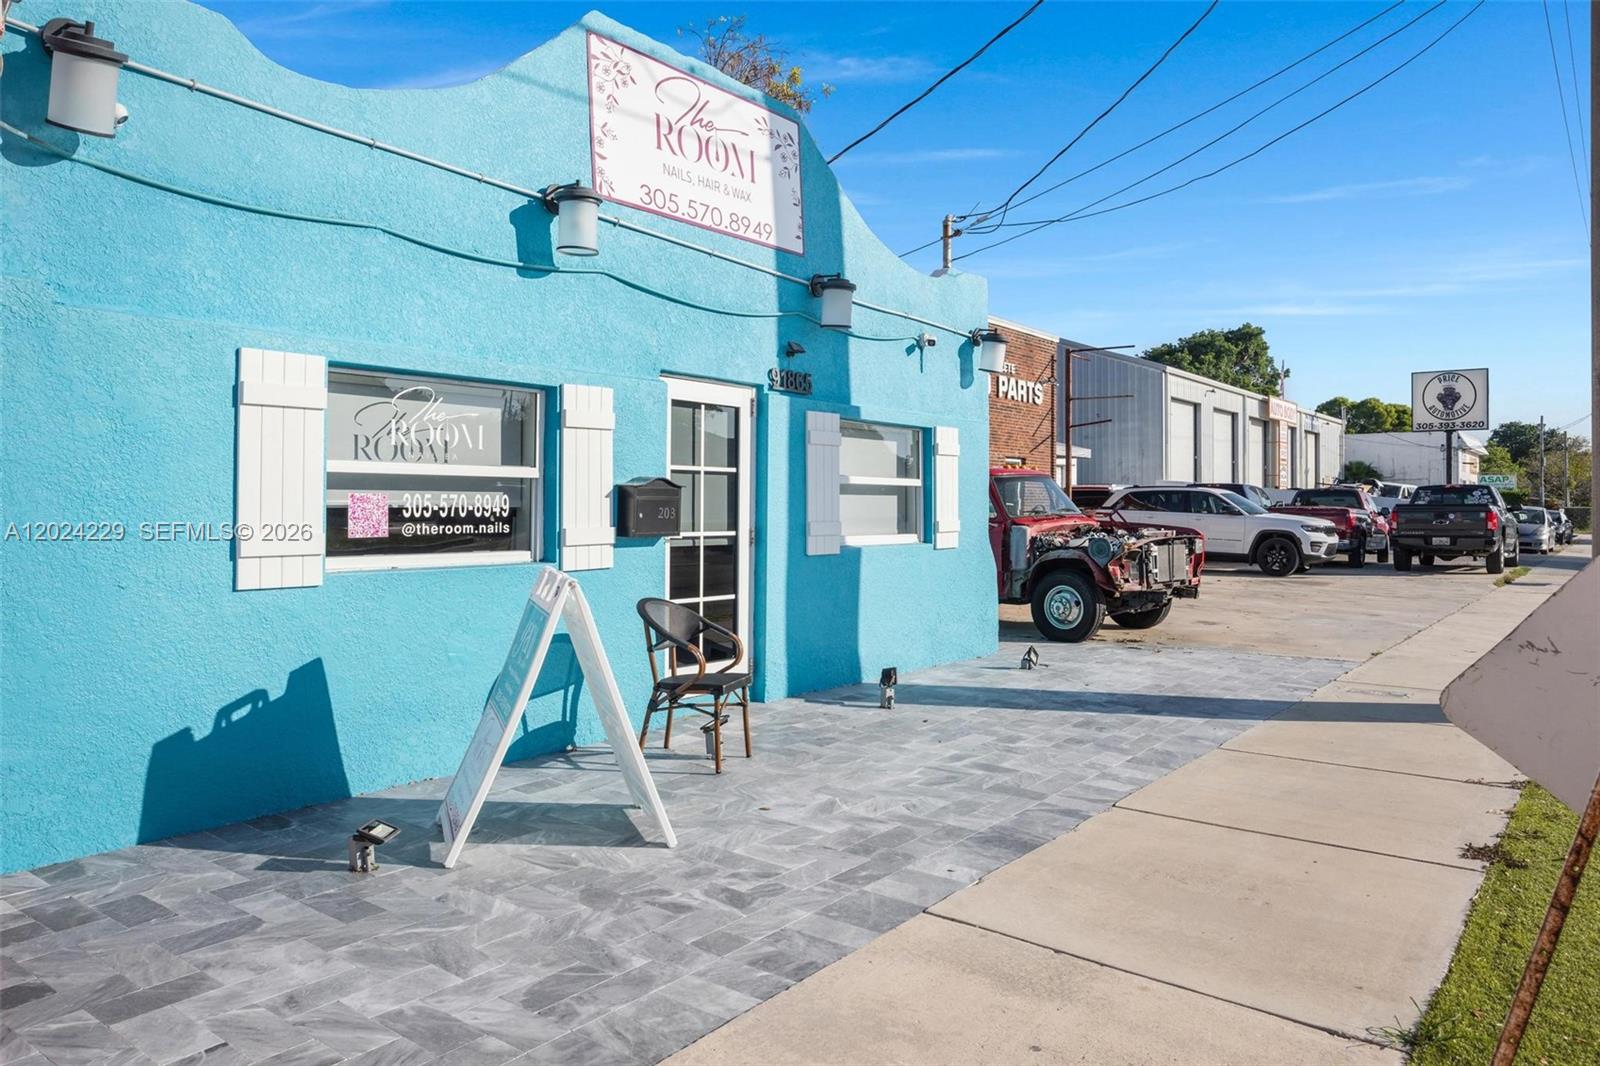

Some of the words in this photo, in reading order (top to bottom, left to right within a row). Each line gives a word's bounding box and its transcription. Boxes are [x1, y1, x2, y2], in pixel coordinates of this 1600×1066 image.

[655, 77, 749, 136] The
[655, 112, 756, 184] ROOM
[662, 163, 694, 186] NAILS,
[698, 177, 720, 193] HAIR
[723, 184, 731, 197] &
[732, 187, 752, 203] WAX
[640, 184, 773, 241] 305.570.8949
[998, 375, 1043, 406] PARTS
[1437, 374, 1460, 384] PRICE
[1428, 403, 1470, 418] AUTOMOTIVE
[391, 418, 483, 450] ROOM
[1415, 420, 1485, 430] 305-393-3620
[1479, 475, 1510, 483] ASAP
[402, 493, 510, 518] 305-570-8949
[657, 507, 676, 519] 203
[402, 521, 510, 537] @theroom.nails
